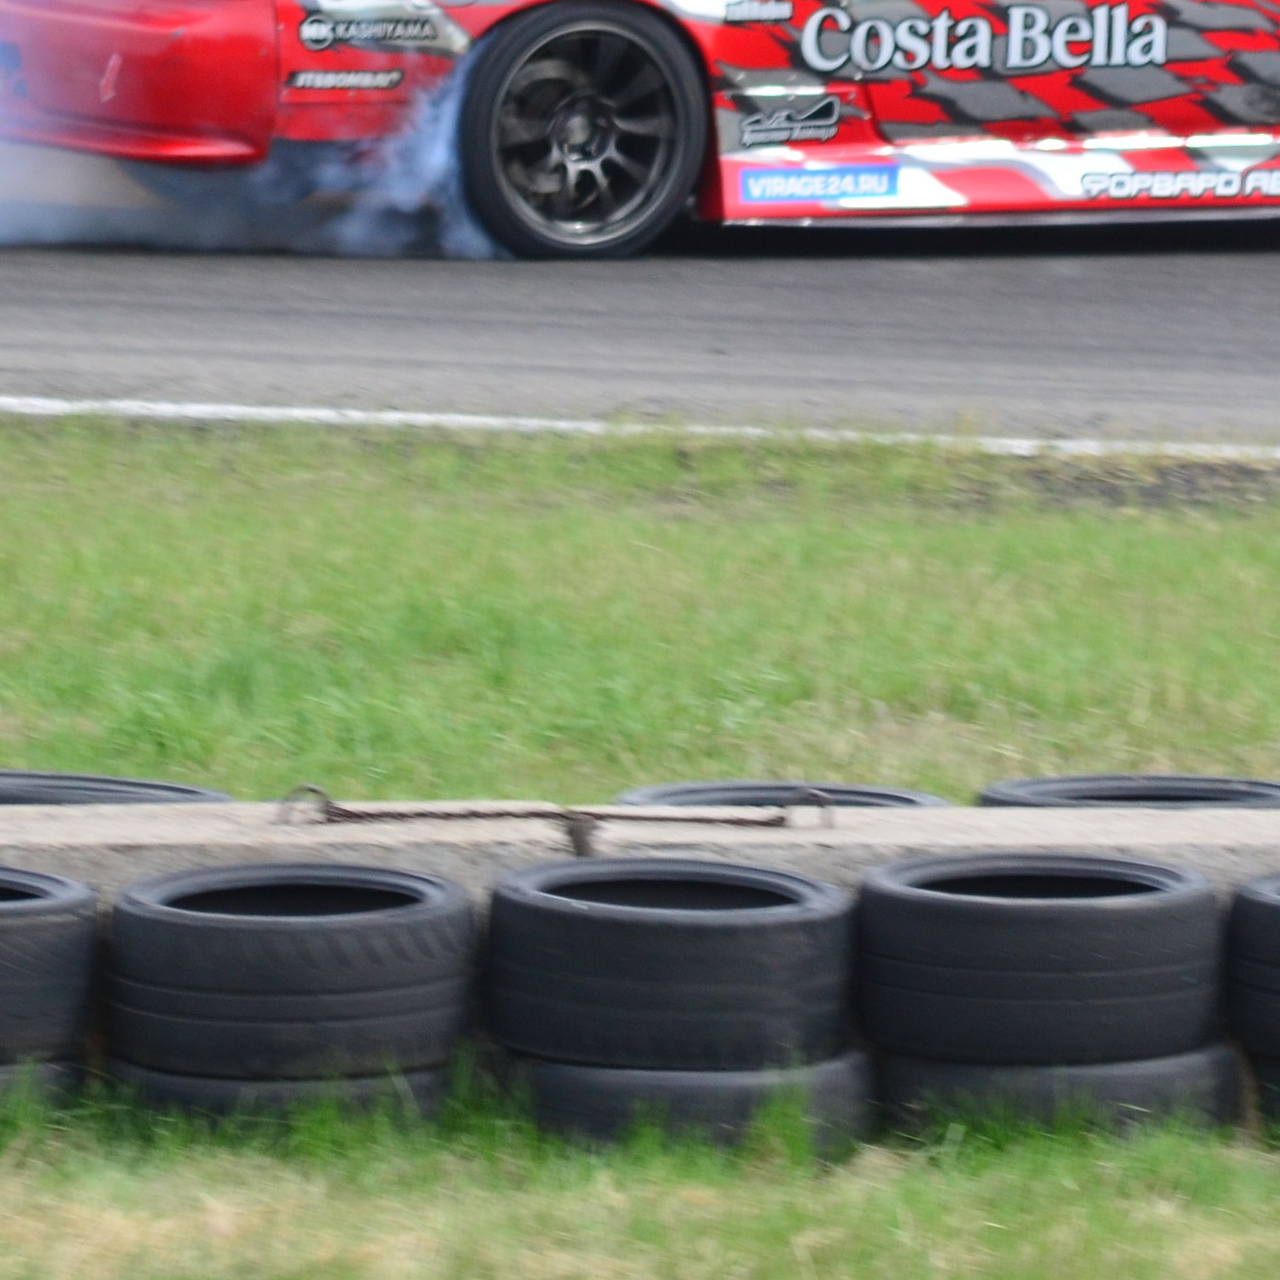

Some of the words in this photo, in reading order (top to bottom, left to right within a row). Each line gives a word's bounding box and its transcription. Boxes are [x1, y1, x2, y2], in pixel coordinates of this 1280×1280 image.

[335, 19, 438, 40] KASHIYAMA
[801, 6, 993, 72] Costa
[1006, 2, 1168, 68] Bella
[749, 174, 890, 199] VIRAGE24.RU
